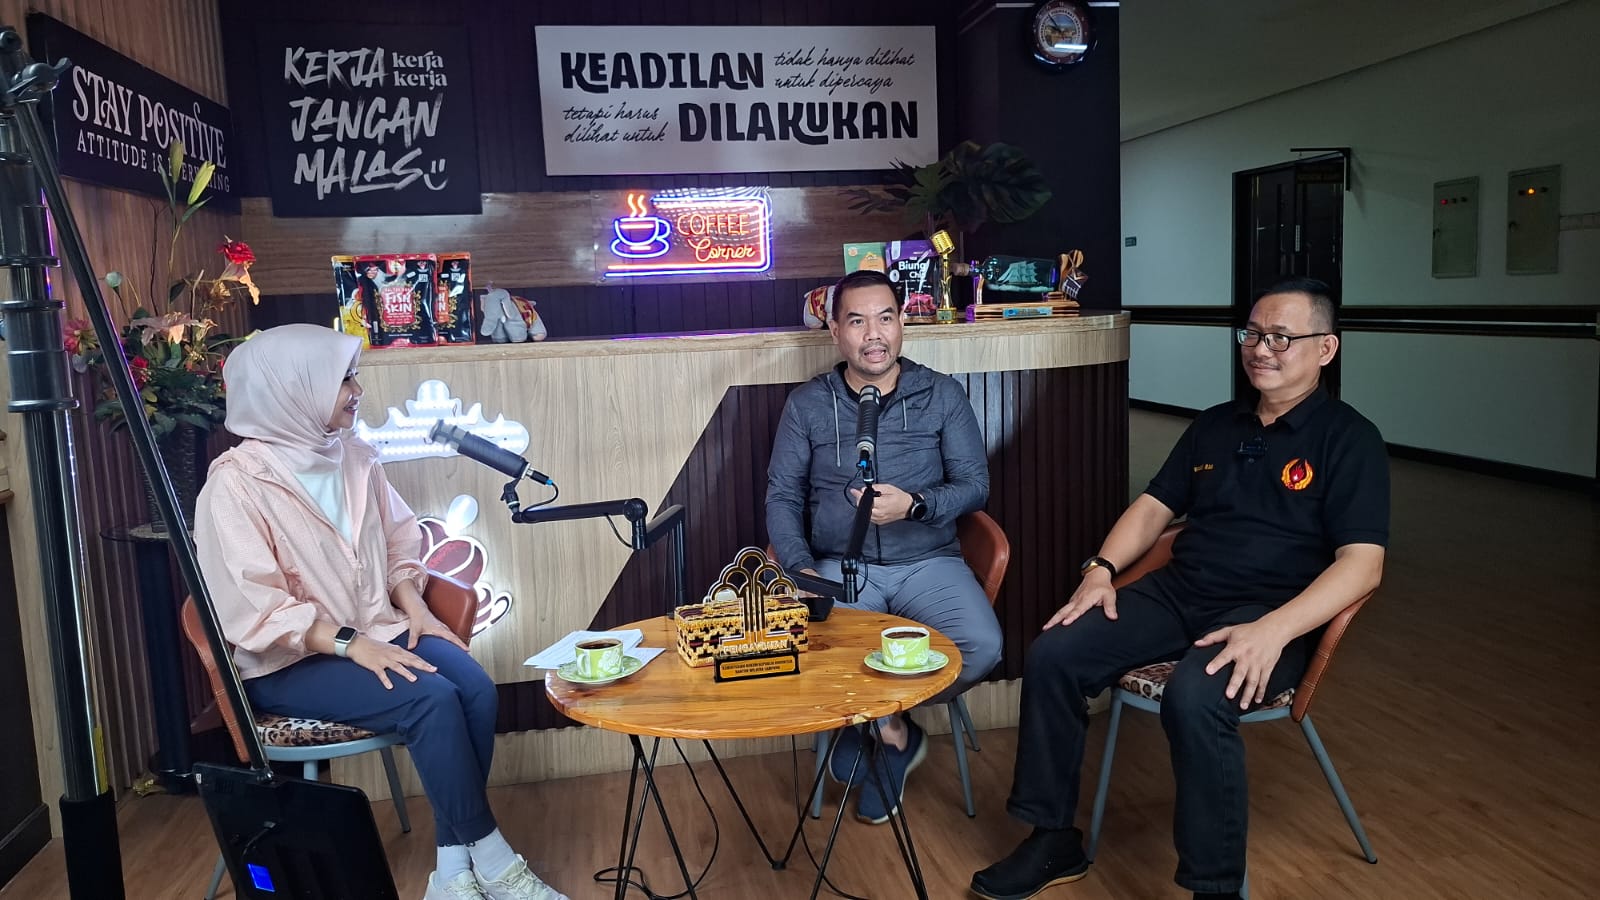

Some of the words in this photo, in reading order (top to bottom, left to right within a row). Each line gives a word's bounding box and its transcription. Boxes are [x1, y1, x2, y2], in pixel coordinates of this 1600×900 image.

[284, 47, 388, 89] KERJA
[392, 51, 444, 71] kerja
[774, 46, 815, 66] tidak
[816, 48, 863, 72] hanya
[865, 48, 915, 66] dilihat
[393, 70, 448, 90] kerja
[560, 52, 764, 94] KEADILAN
[775, 68, 819, 89] untuk
[819, 71, 894, 96] dipercaya
[72, 65, 133, 136] STAY
[138, 94, 227, 169] POSITIVE
[289, 92, 443, 149] JANGAN
[562, 104, 613, 125] tetapi
[614, 101, 660, 120] harus
[678, 100, 918, 146] DILAKUKAN
[564, 121, 620, 143] dilihat
[622, 121, 669, 143] untuk
[77, 129, 147, 170] ATTITUDE
[152, 152, 163, 174] IS
[294, 147, 424, 200] MALAS
[677, 213, 750, 235] COFFEE
[687, 238, 756, 262] Corner
[384, 291, 412, 304] FISH
[384, 303, 413, 314] SKIN
